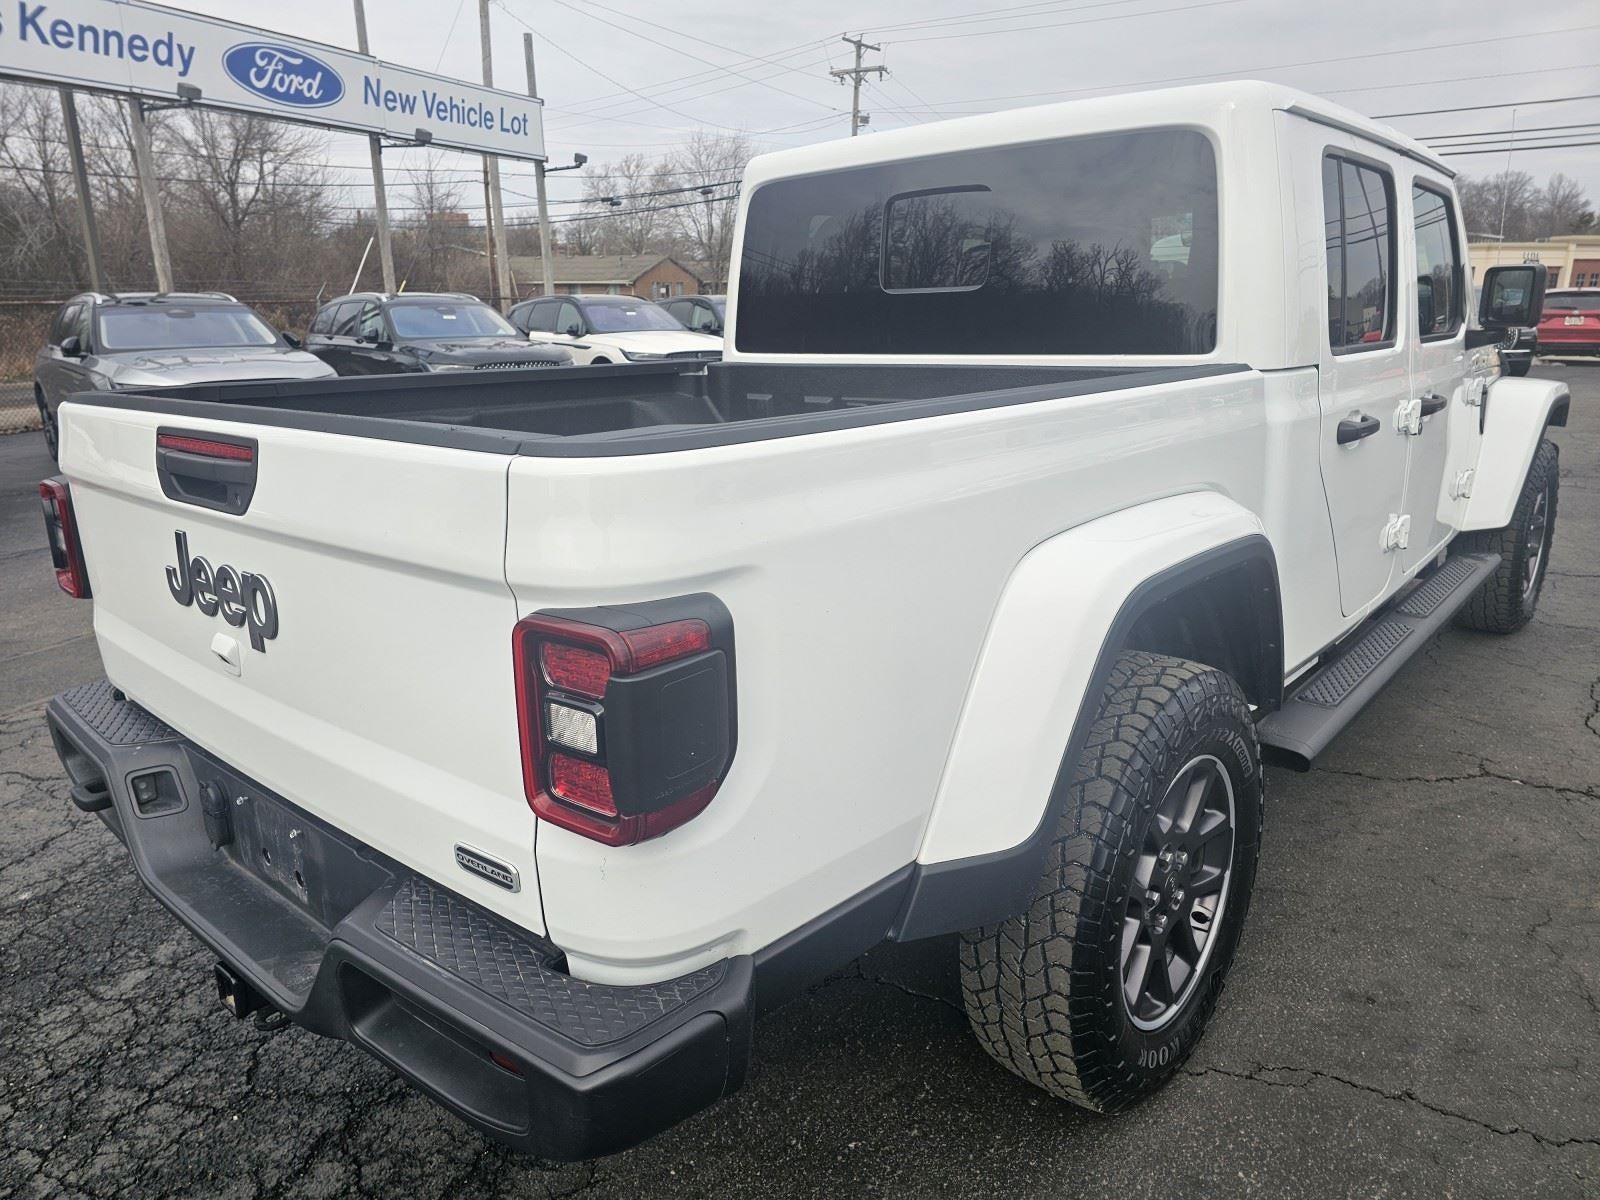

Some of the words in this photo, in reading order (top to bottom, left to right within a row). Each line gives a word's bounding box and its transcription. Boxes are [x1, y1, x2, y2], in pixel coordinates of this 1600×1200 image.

[18, 1, 196, 77] Kennedy
[249, 48, 323, 99] Ford
[364, 75, 417, 115] New
[422, 90, 494, 130] Vehicle
[500, 107, 528, 136] Lot
[165, 529, 279, 653] Jeep
[456, 853, 514, 883] OVERLAND
